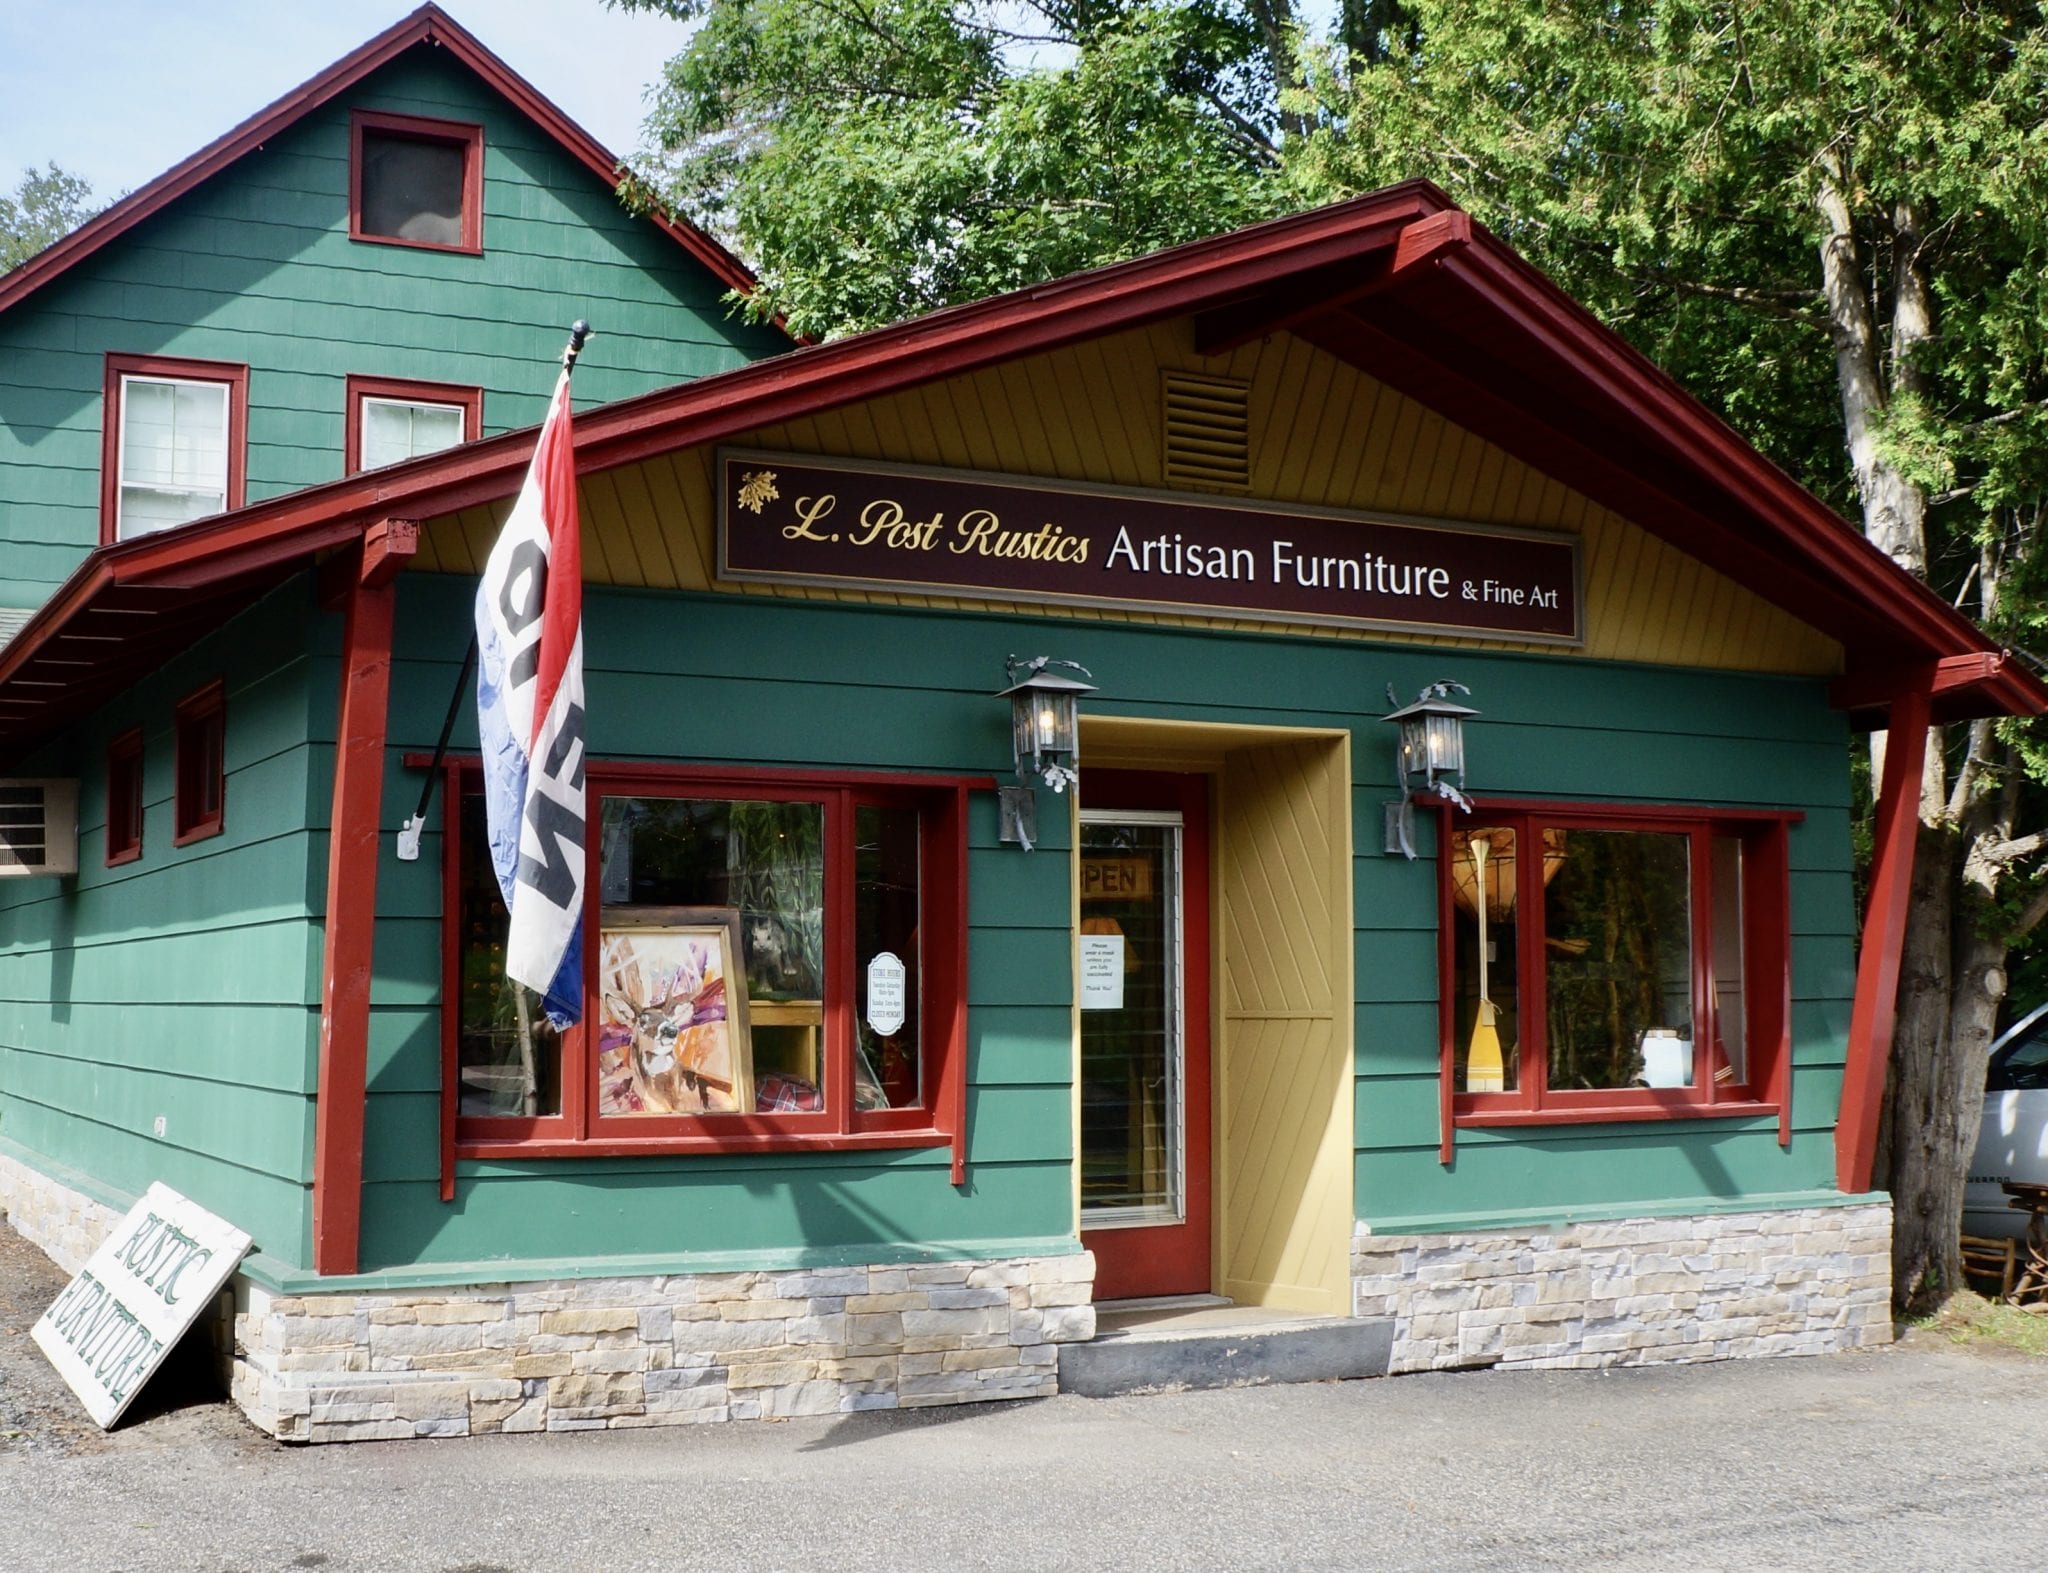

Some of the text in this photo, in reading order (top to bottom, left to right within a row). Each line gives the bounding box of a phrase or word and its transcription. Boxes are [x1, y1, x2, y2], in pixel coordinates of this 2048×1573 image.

[782, 494, 1559, 609] L. Post Rustics Artisan Furniture & Fine Art
[1080, 864, 1137, 892] PEN
[114, 1212, 216, 1305] RUSTIC
[46, 1269, 164, 1406] FURNITURE
